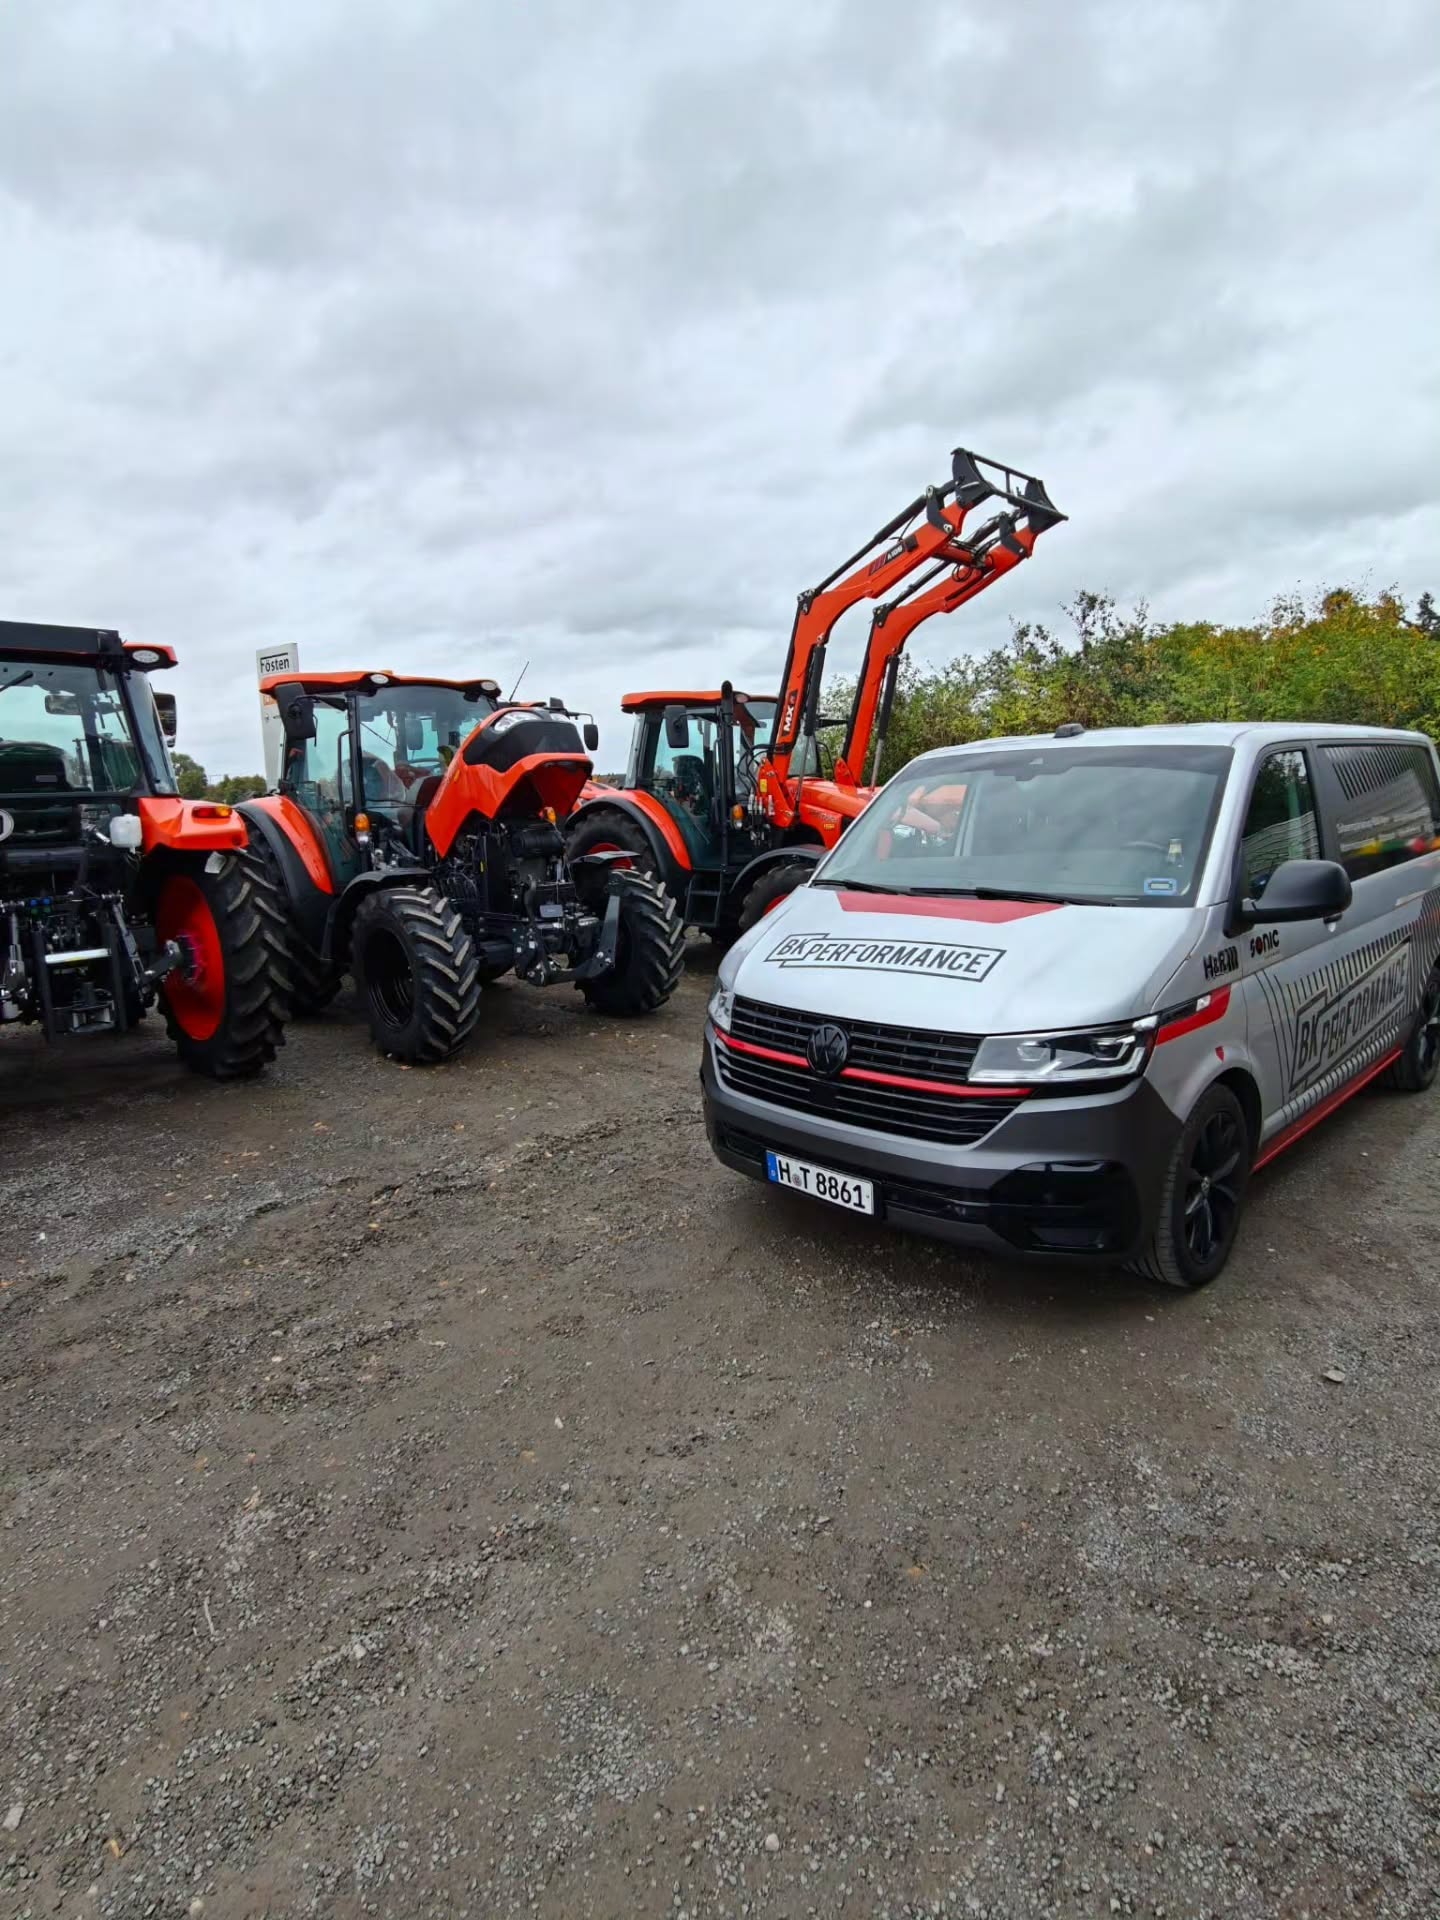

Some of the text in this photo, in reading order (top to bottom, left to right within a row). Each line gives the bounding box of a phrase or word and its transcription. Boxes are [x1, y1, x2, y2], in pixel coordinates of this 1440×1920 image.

[260, 653, 290, 673] Fösten
[783, 704, 795, 732] MX
[805, 942, 990, 974] PERFORMANCE
[1321, 952, 1408, 1061] PERFORMANCE
[778, 1159, 866, 1210] H T 8861
